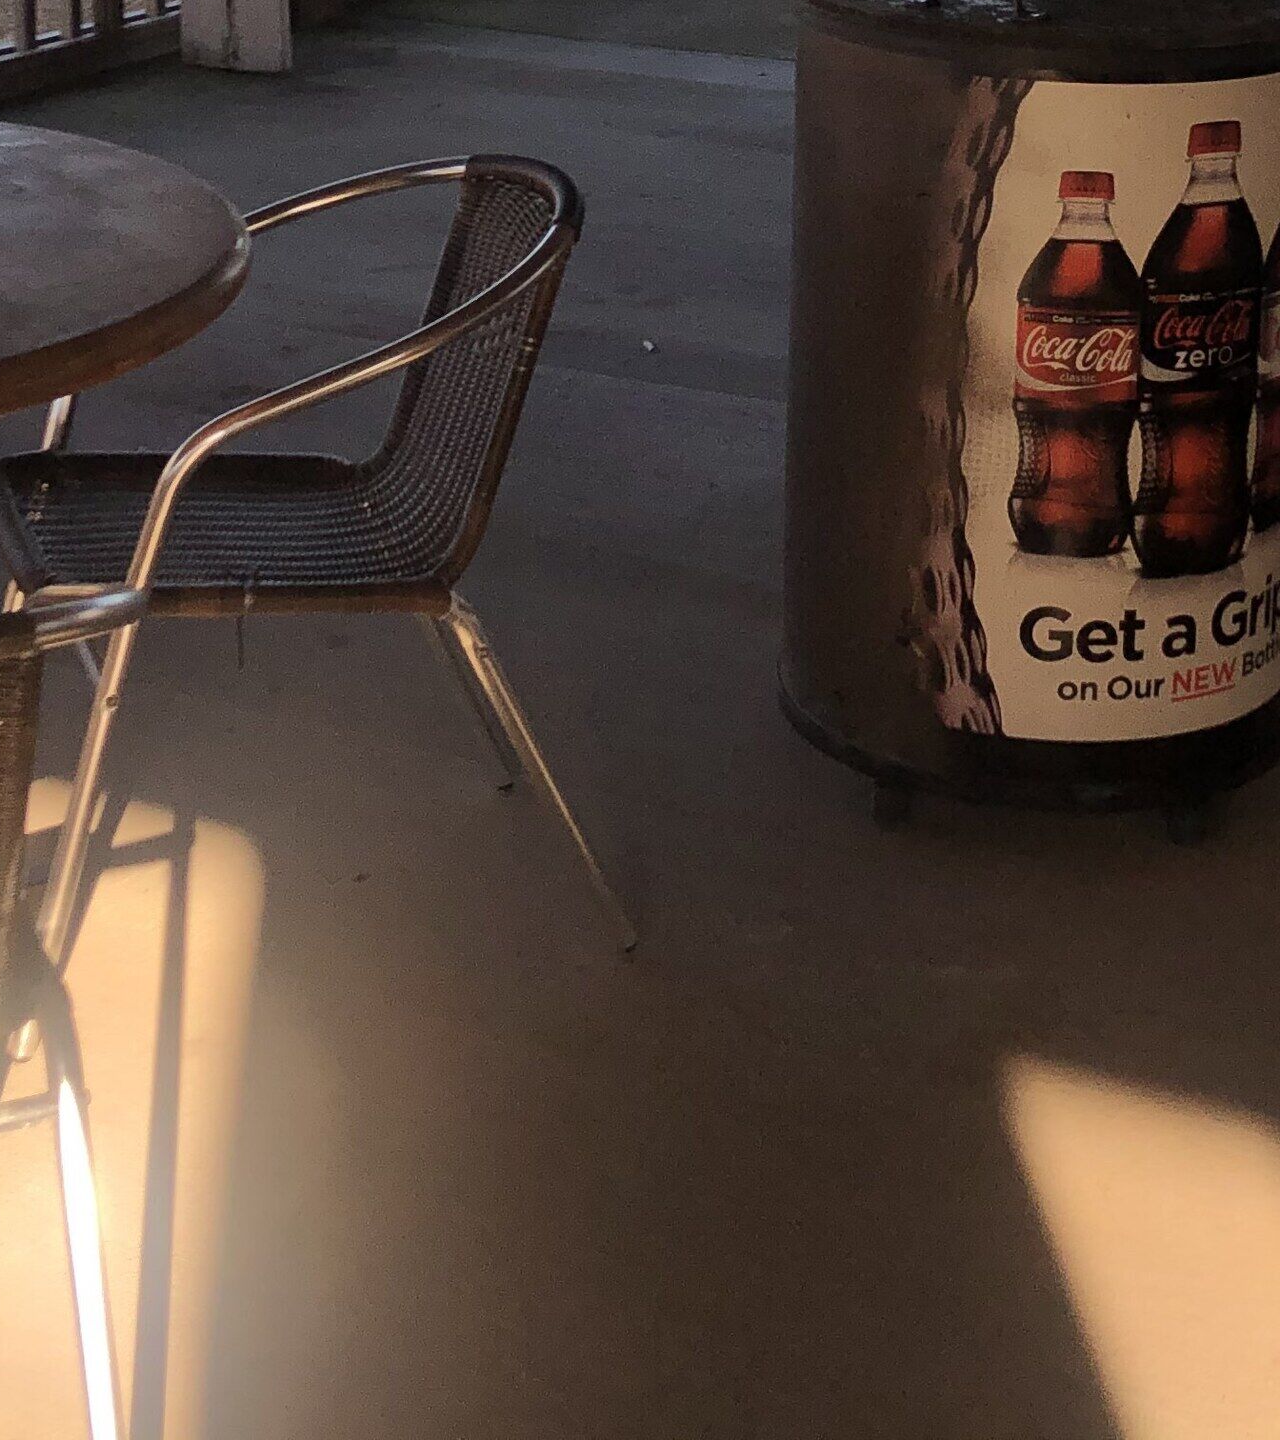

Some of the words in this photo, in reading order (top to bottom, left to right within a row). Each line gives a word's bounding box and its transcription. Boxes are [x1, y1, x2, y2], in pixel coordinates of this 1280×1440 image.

[1023, 325, 1136, 373] Coca-Cola
[1175, 345, 1233, 369] zero
[1059, 373, 1096, 383] classic
[1019, 605, 1146, 663] Get
[1162, 614, 1197, 658] a
[1057, 681, 1098, 701] on
[1107, 675, 1165, 700] Our
[1172, 657, 1237, 695] NEW
